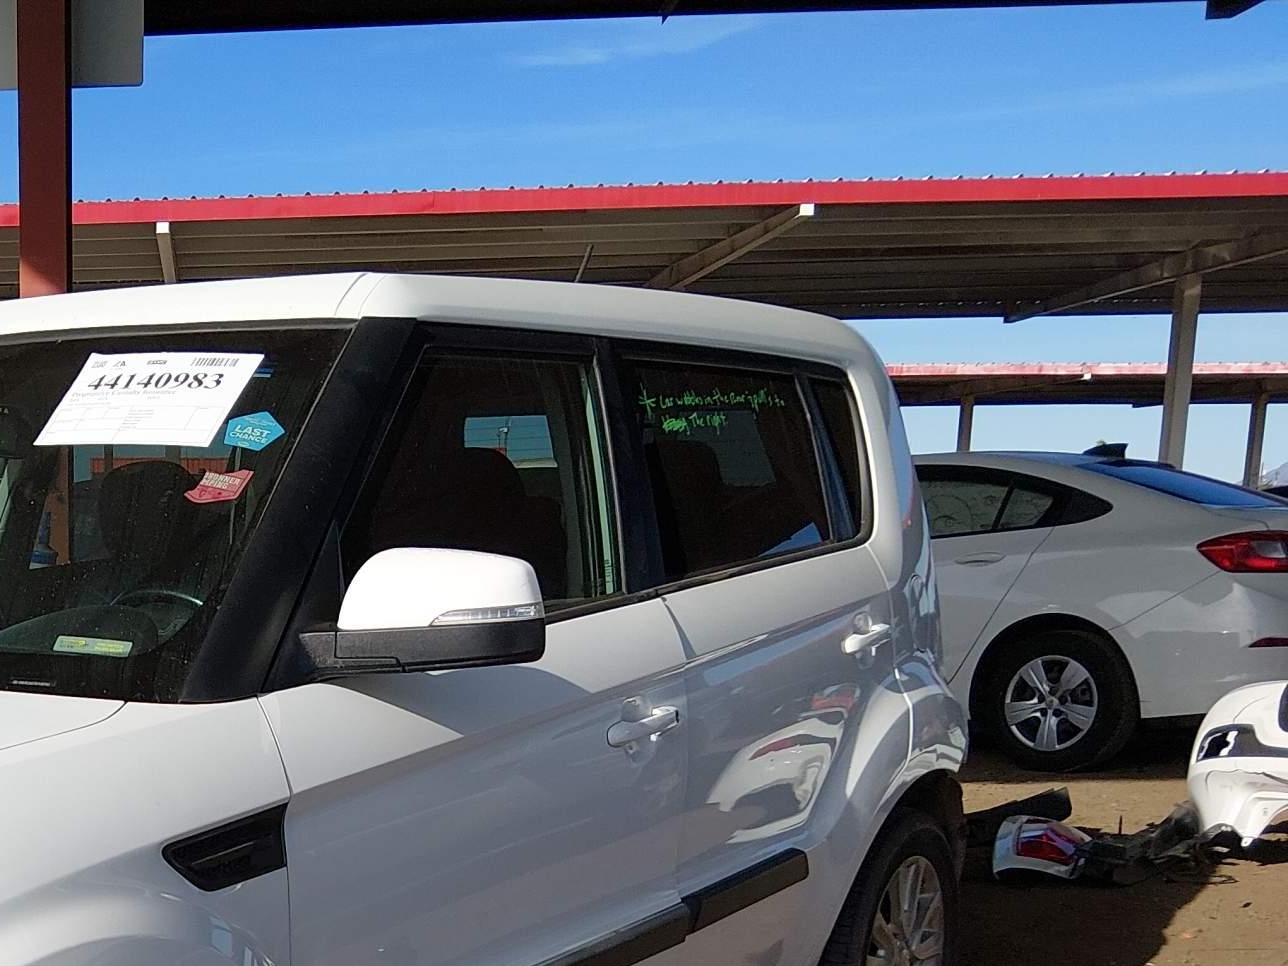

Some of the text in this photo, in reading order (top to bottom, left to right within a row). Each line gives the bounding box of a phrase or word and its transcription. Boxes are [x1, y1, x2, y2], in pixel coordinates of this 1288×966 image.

[87, 371, 225, 391] 44140983
[229, 431, 268, 444] CHANCE
[234, 424, 271, 438] LAST
